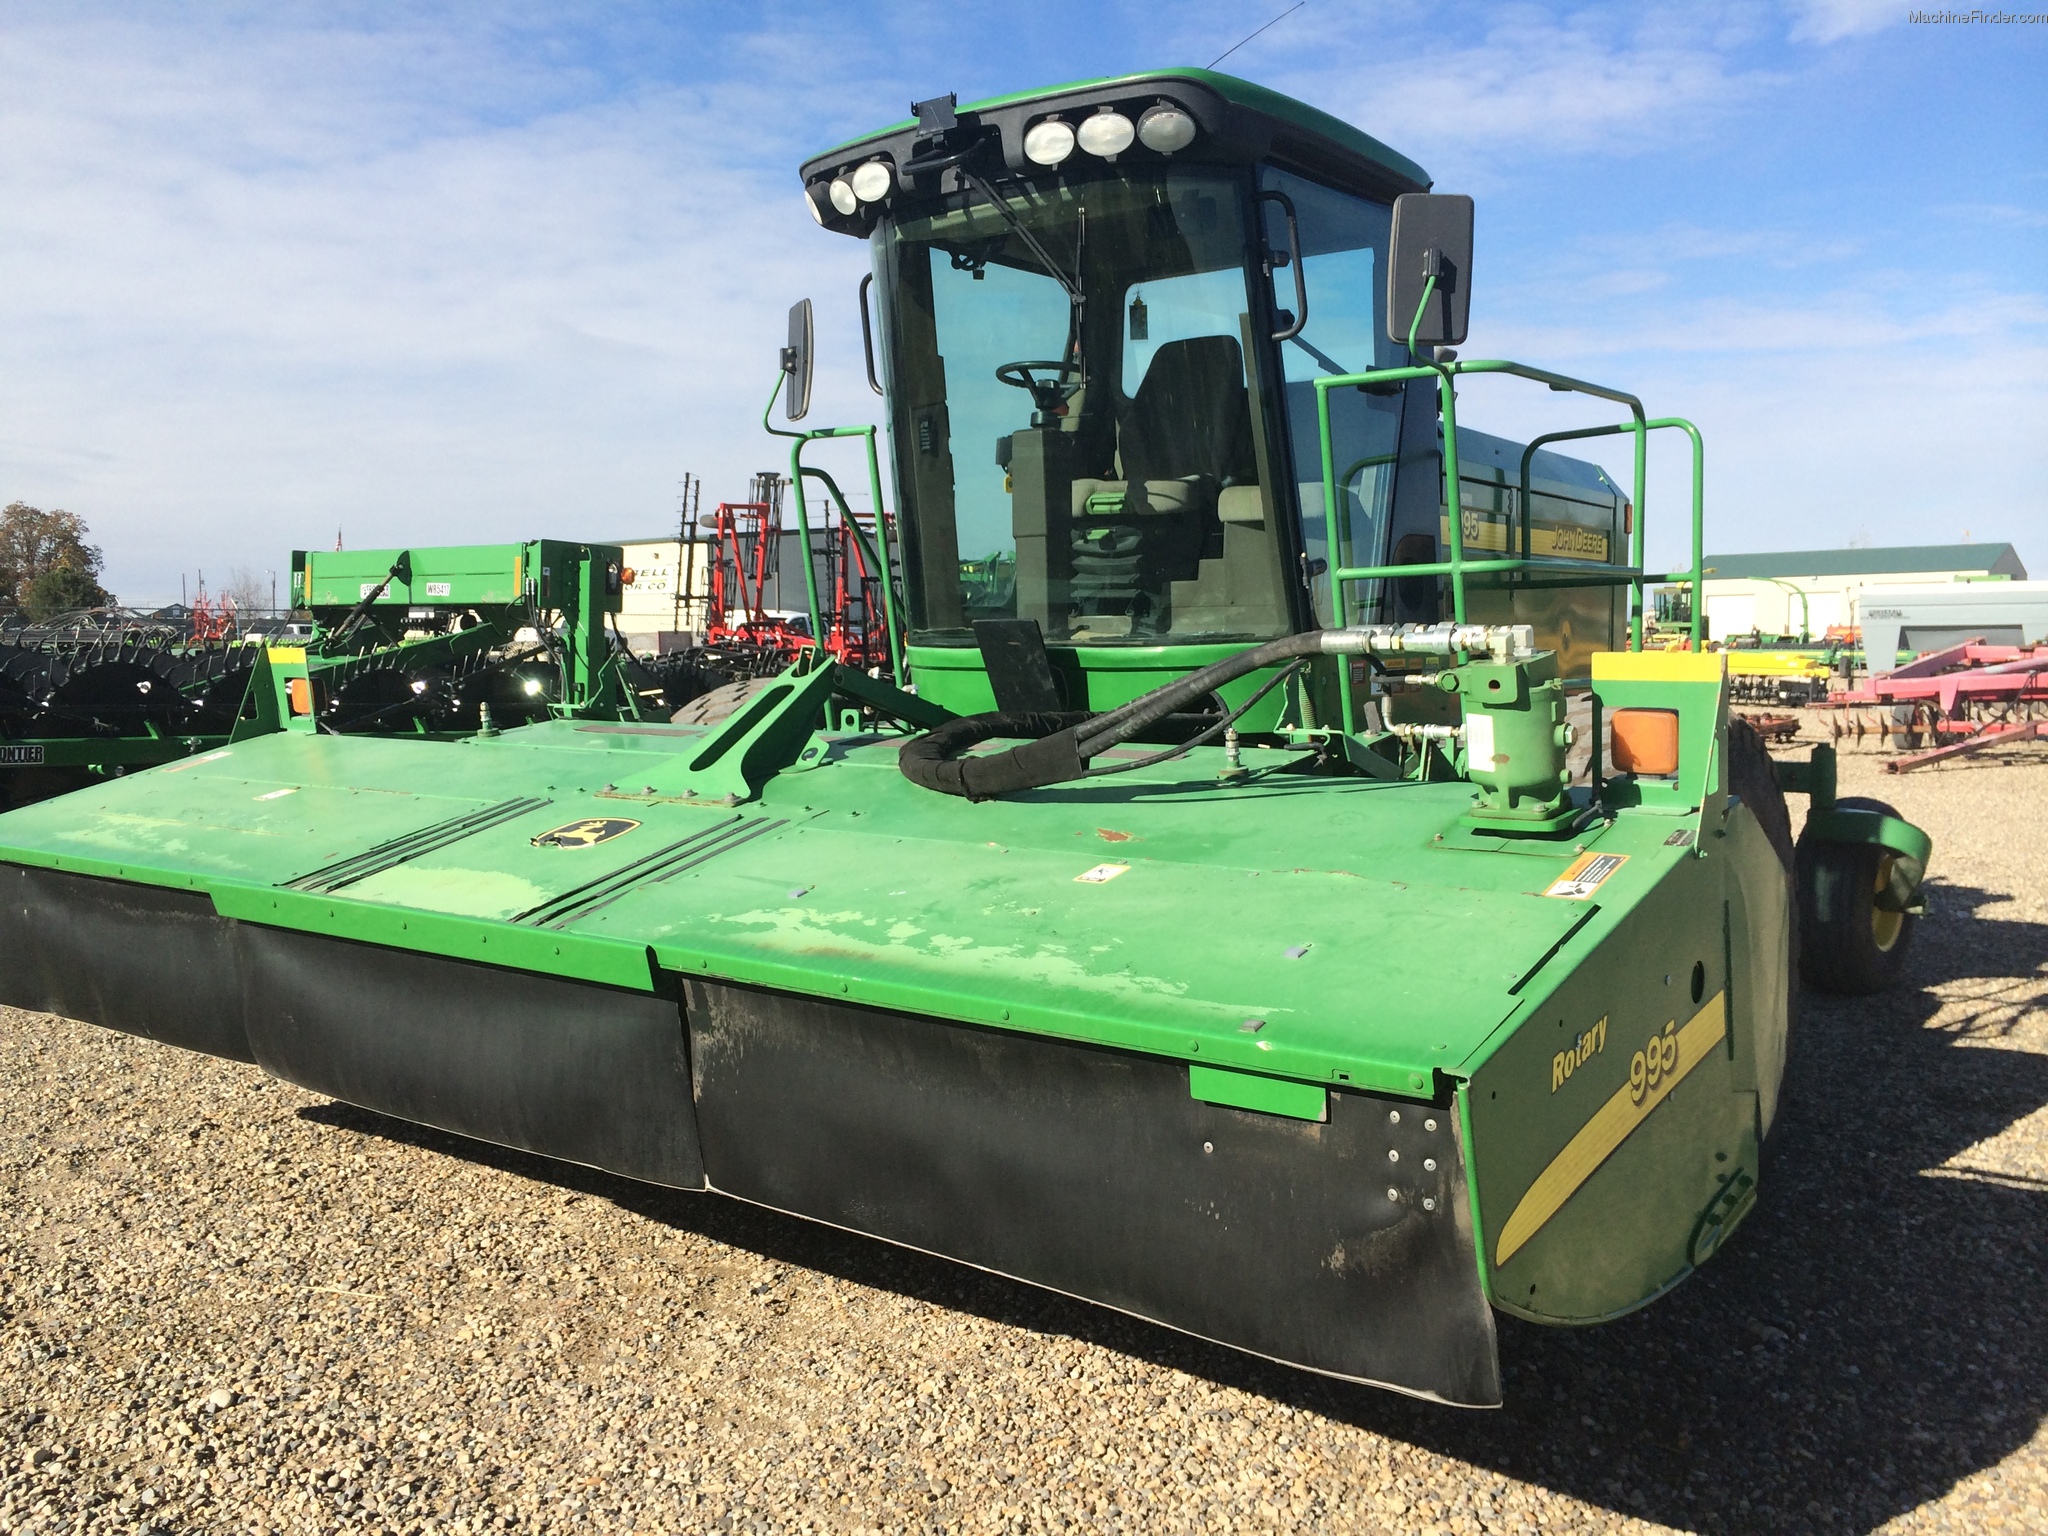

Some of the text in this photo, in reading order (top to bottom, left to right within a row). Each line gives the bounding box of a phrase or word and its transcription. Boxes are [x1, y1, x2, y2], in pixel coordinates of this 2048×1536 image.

[1460, 510, 1479, 540] 95
[1552, 525, 1603, 555] JOHN DEERE
[647, 582, 666, 590] CO
[1551, 1014, 1608, 1094] Rotary
[1630, 1019, 1677, 1106] 995
